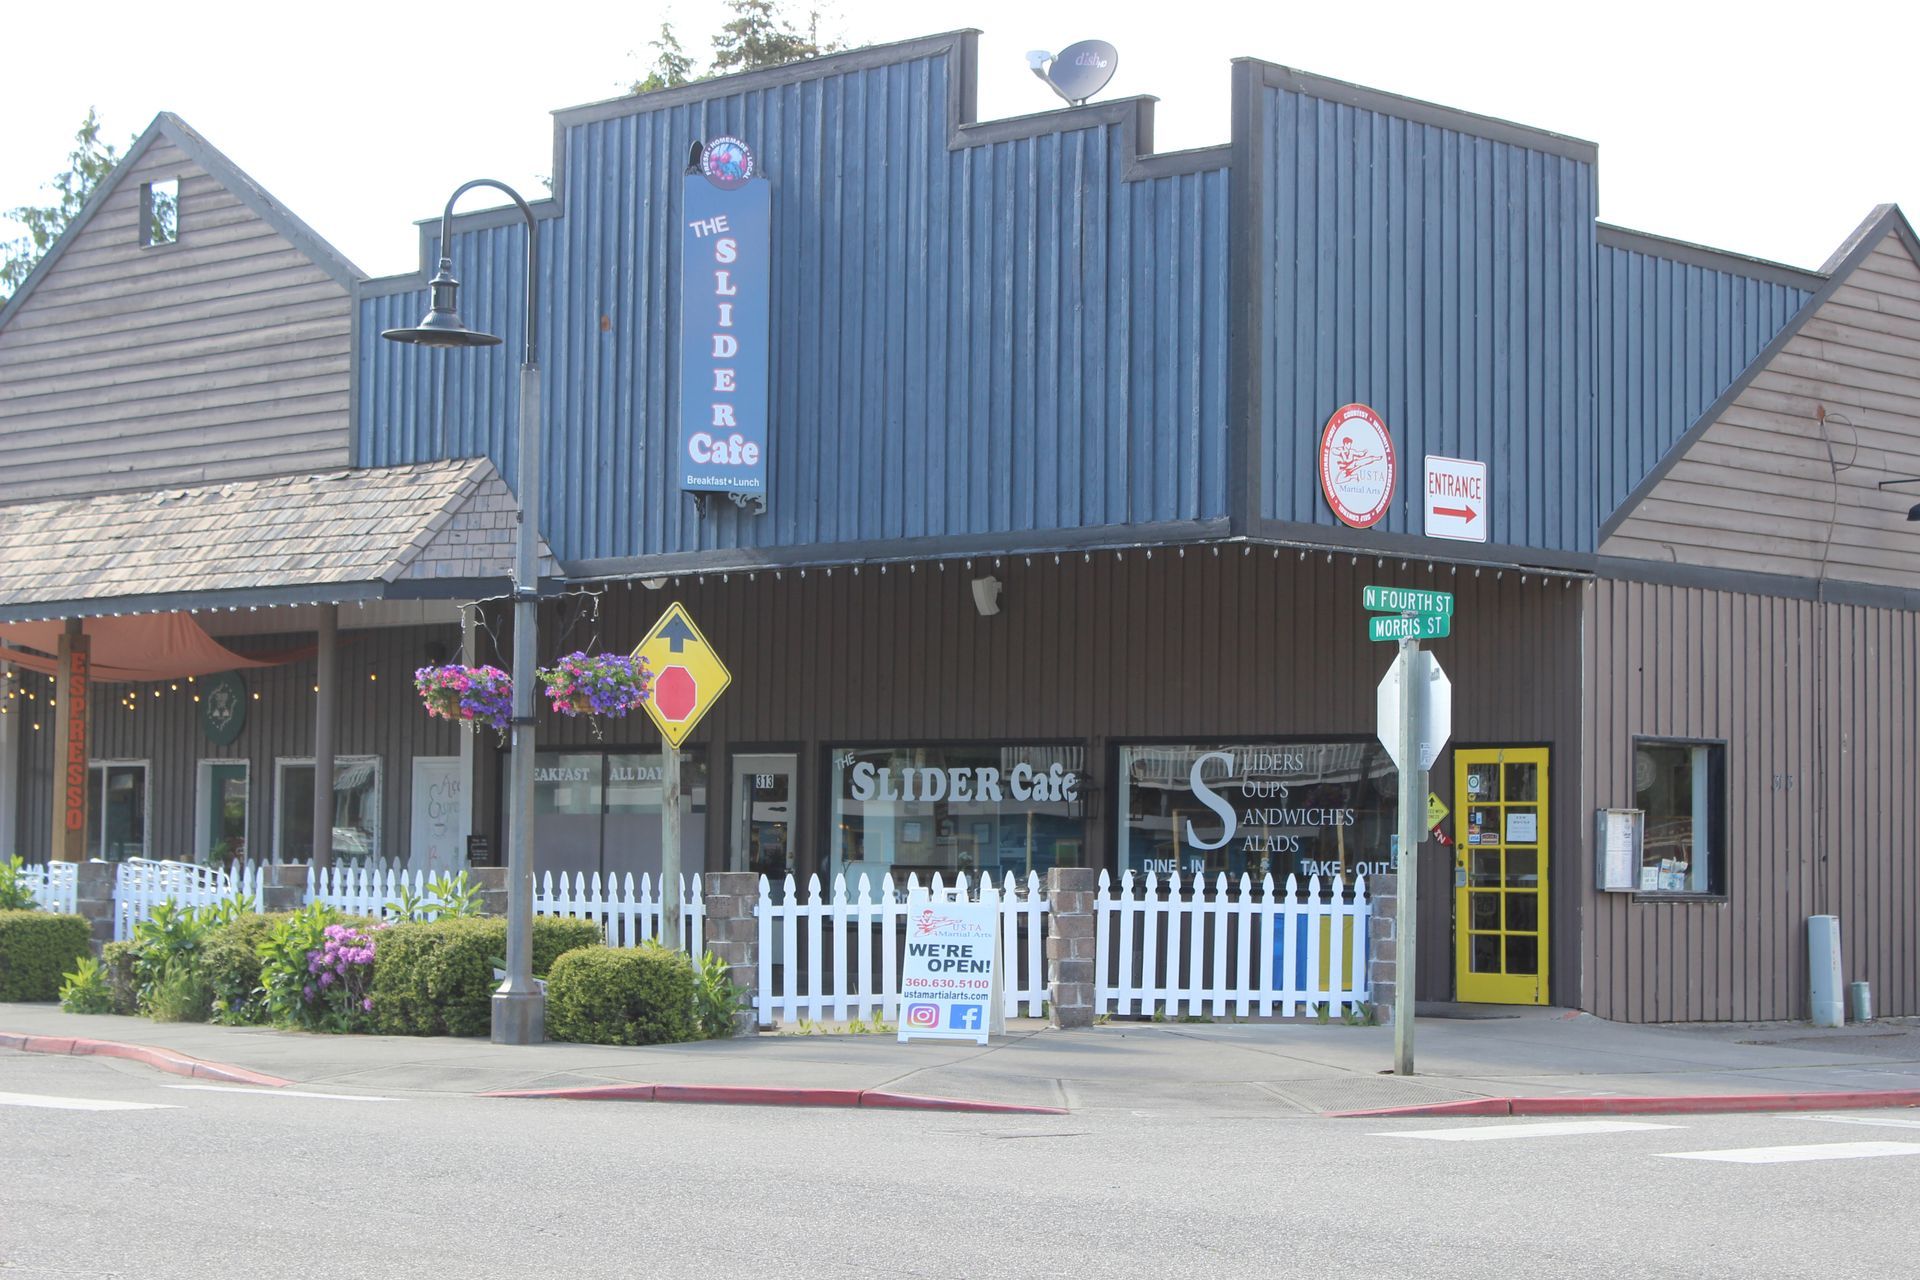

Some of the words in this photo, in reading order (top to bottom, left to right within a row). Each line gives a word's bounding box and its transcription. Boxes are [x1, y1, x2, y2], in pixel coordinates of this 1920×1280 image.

[703, 151, 711, 176] FRESH
[710, 137, 749, 152] HOMEMADE
[743, 156, 754, 179] LOCAL
[690, 216, 729, 238] THE
[712, 238, 737, 427] SLIDER
[688, 433, 759, 466] Cafe
[687, 475, 727, 486] Breakfast
[733, 476, 760, 487] Lunch
[1360, 470, 1385, 482] USTA
[1340, 485, 1365, 495] Martial
[1366, 487, 1381, 495] Arts
[1429, 471, 1482, 500] ENTRANCE
[1366, 589, 1376, 607] N
[1381, 591, 1432, 611] FOURTH
[1435, 596, 1451, 613] ST
[1376, 618, 1421, 637] MORRIS
[1427, 617, 1442, 634] ST
[66, 652, 86, 830] ESPRESSO
[835, 751, 856, 771] THE
[1242, 753, 1304, 771] LIDERS
[534, 768, 590, 781] EAKFAST
[610, 767, 635, 780] ALL
[637, 766, 663, 780] DAY
[757, 775, 773, 788] 313
[851, 761, 1003, 801] SLIDER
[1010, 762, 1078, 802] Cafe
[1242, 781, 1289, 799] OUPS
[1186, 752, 1238, 850] S
[1243, 808, 1355, 826] ANDWICHES
[1242, 835, 1299, 852] ALADS
[1144, 859, 1178, 873] DINE
[1191, 859, 1205, 873] IN
[1301, 861, 1341, 875] TAKE
[1356, 862, 1389, 876] OUT
[952, 923, 982, 931] USTA
[909, 943, 973, 957] WE'RE
[928, 959, 991, 973] OPEN!
[905, 978, 989, 988] 360.630.5100
[904, 990, 989, 1000] ustamartialarts.com
